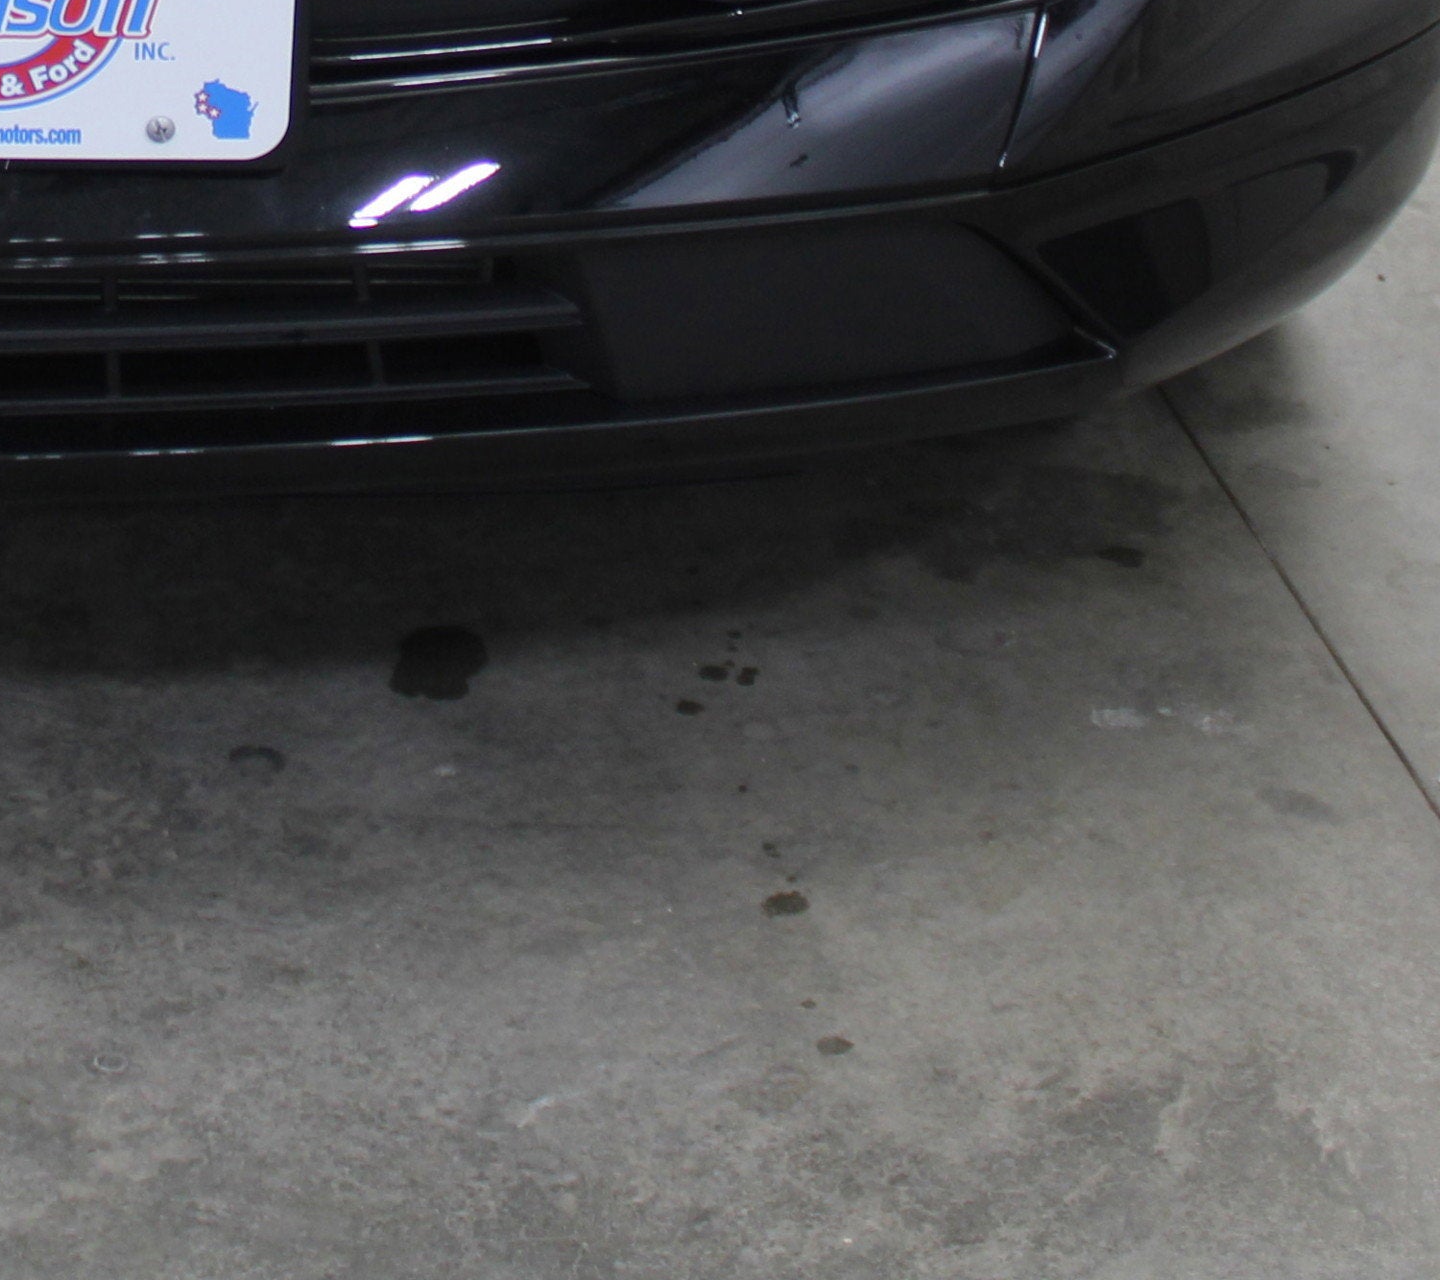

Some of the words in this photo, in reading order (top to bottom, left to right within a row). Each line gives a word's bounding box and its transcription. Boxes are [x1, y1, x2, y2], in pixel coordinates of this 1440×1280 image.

[0, 73, 26, 97] &
[28, 39, 98, 91] Ford
[133, 42, 176, 61] INC.
